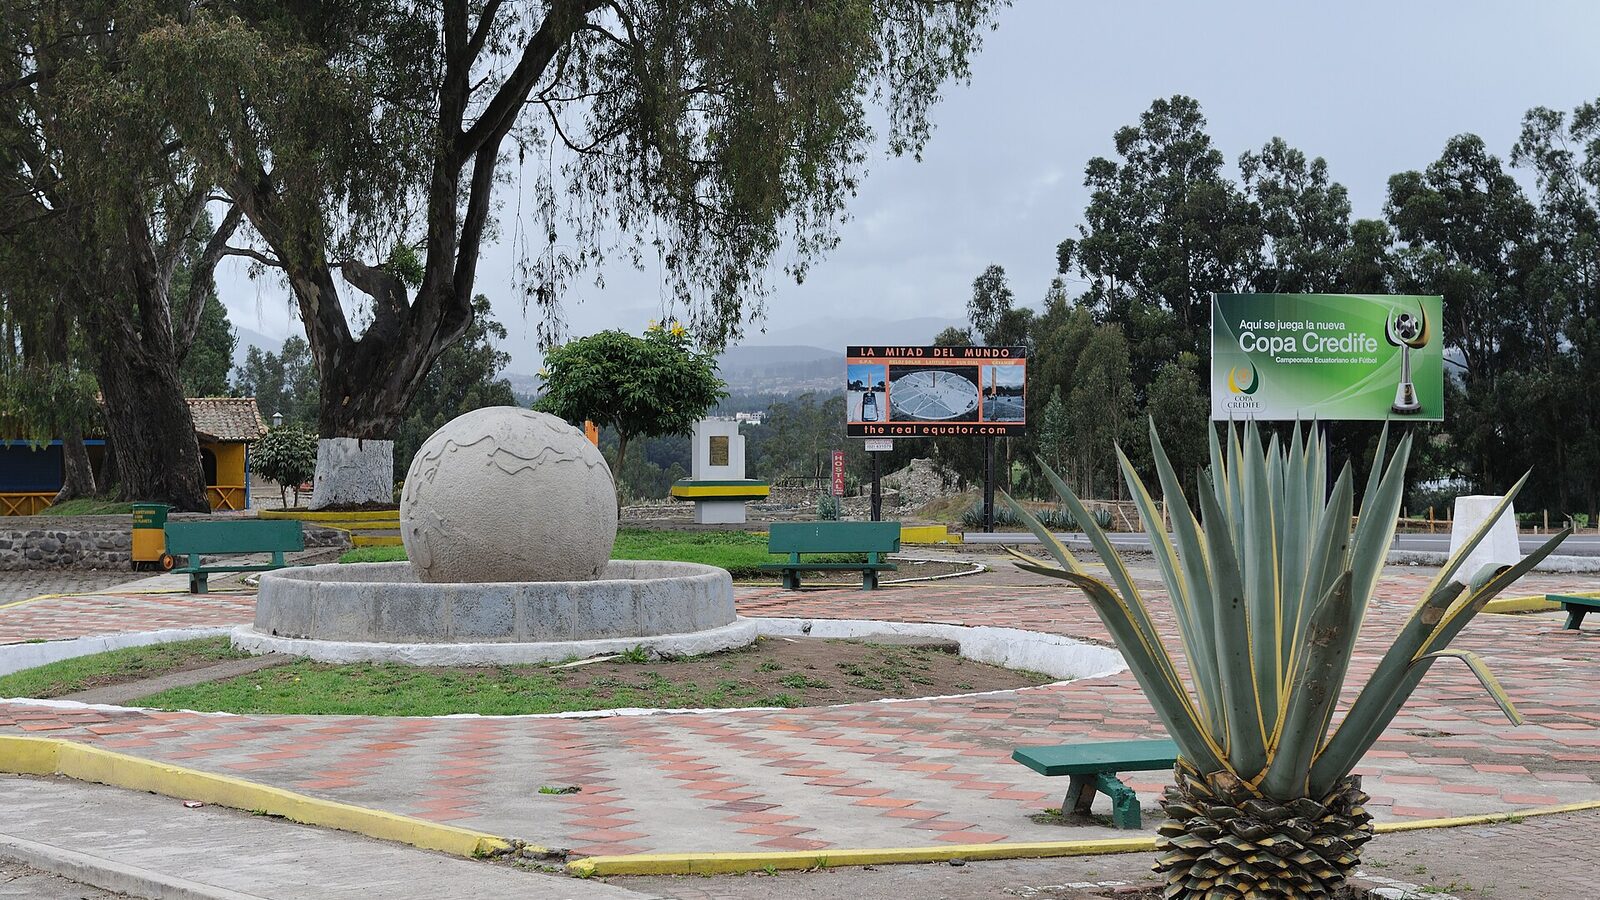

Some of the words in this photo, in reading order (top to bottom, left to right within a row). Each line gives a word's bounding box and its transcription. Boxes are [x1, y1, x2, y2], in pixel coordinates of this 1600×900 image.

[1239, 320, 1262, 332] Aquí
[1264, 322, 1275, 330] se
[1277, 320, 1304, 332] juega
[1306, 320, 1315, 330] la
[1316, 321, 1346, 330] nueva
[1239, 331, 1297, 357] Copa
[1302, 332, 1378, 353] Credife
[860, 347, 875, 357] LA
[885, 347, 923, 357] MITAD
[933, 347, 954, 357] DEL
[964, 348, 1010, 358] MUNDO
[1275, 356, 1314, 364] Campeonato
[1314, 356, 1349, 364] Ecuatoriano
[1358, 356, 1378, 364] Fútbol
[1227, 401, 1261, 409] CREDIFE
[864, 425, 885, 434] the
[890, 425, 917, 434] real
[922, 425, 1007, 436] equator.com
[834, 455, 843, 490] HOSTAL
